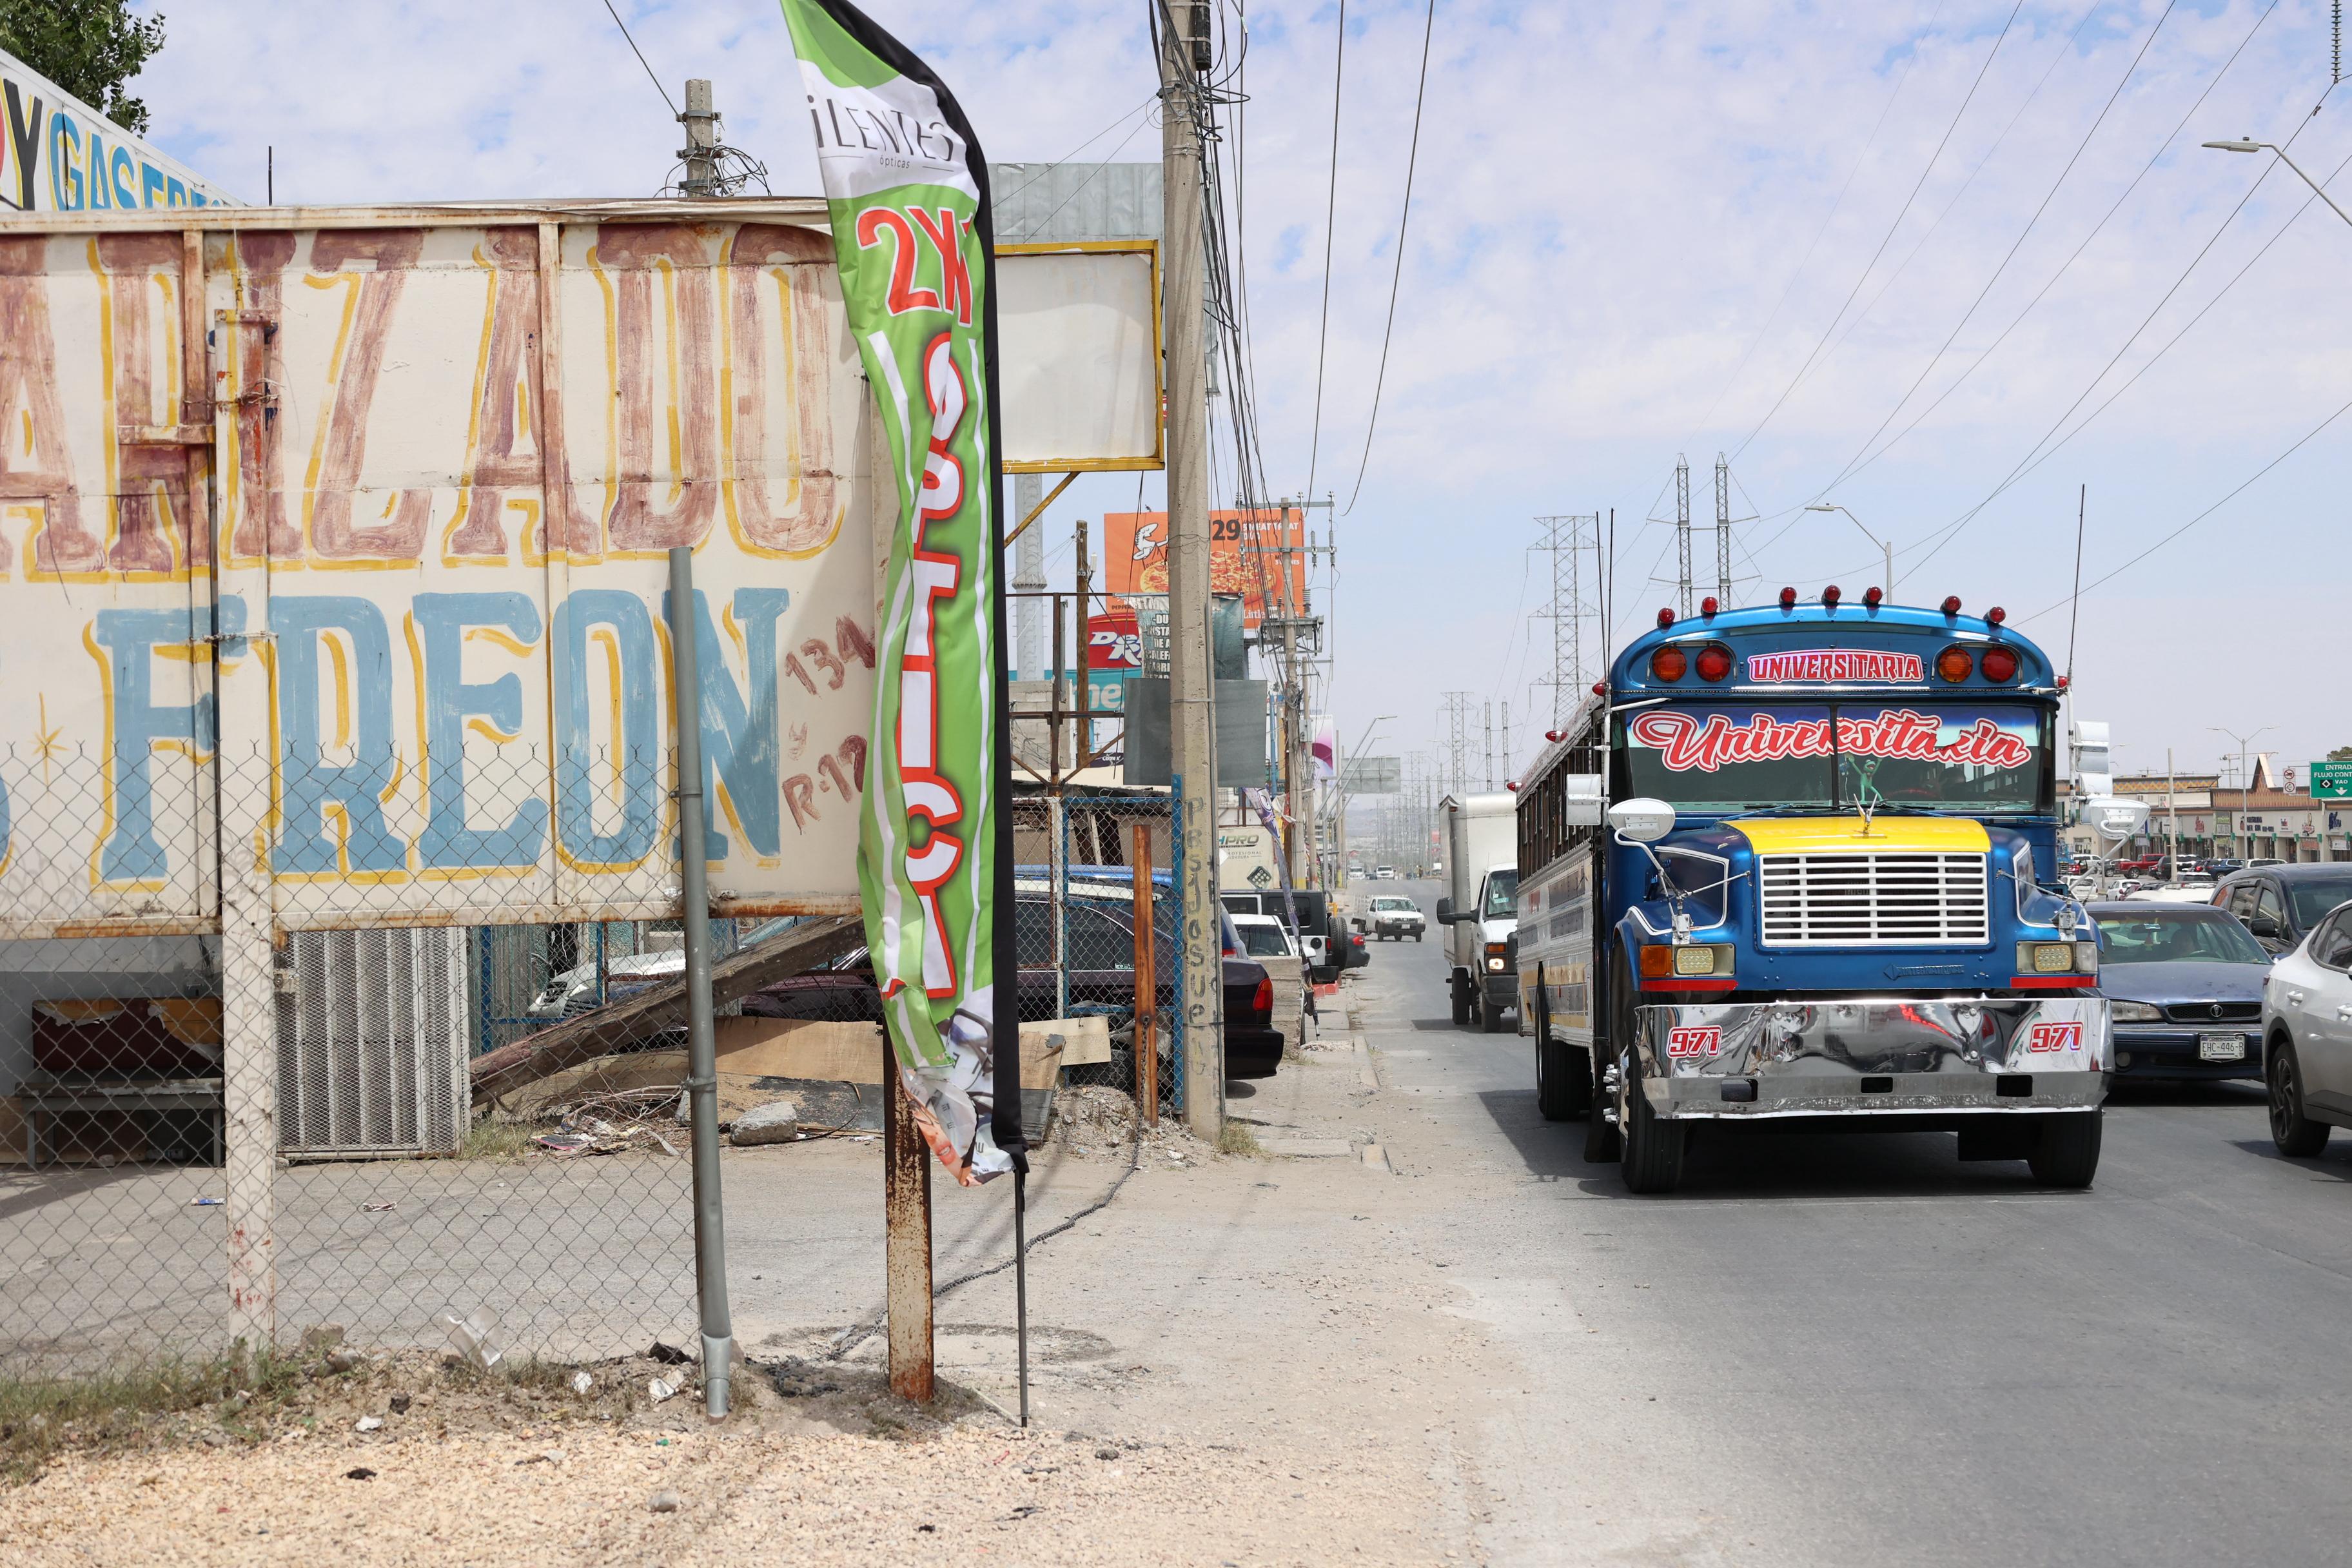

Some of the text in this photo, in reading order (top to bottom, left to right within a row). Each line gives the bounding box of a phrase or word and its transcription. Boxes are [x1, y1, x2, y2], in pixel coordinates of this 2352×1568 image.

[879, 155, 910, 169] ópticas
[1213, 519, 1241, 540] 29
[1090, 631, 1140, 645] De
[1750, 650, 1924, 683] UNIVERSITARIA
[97, 588, 788, 882] FREON
[1667, 1025, 1722, 1059] 971
[2030, 1021, 2084, 1053] 971
[2202, 1042, 2244, 1052] EHC-446-B
